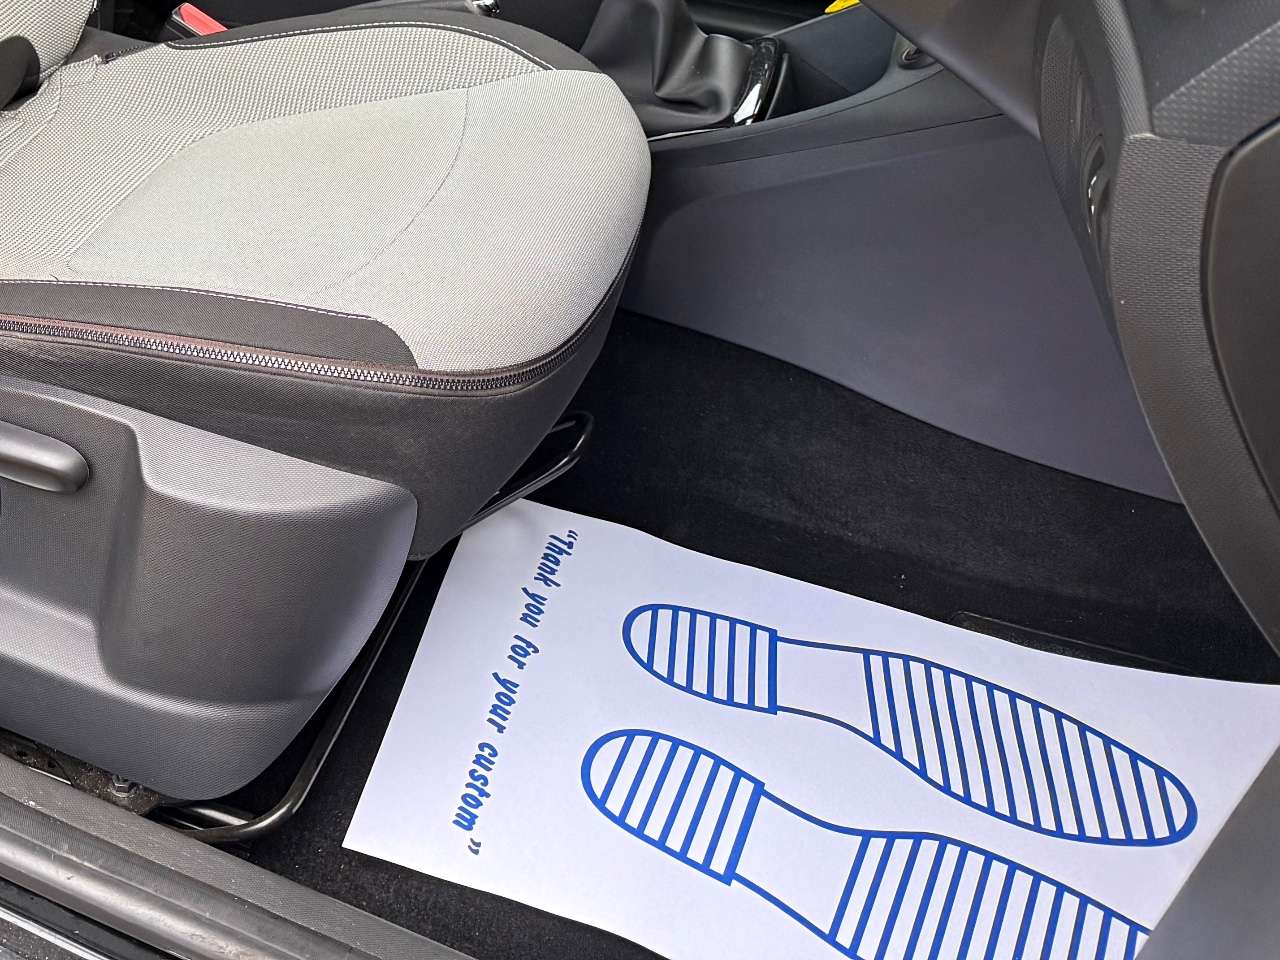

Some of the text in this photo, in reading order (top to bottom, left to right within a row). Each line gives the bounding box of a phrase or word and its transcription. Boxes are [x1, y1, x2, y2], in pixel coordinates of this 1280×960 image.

[519, 586, 548, 628] you
[507, 633, 540, 670] for
[486, 670, 521, 735] your
